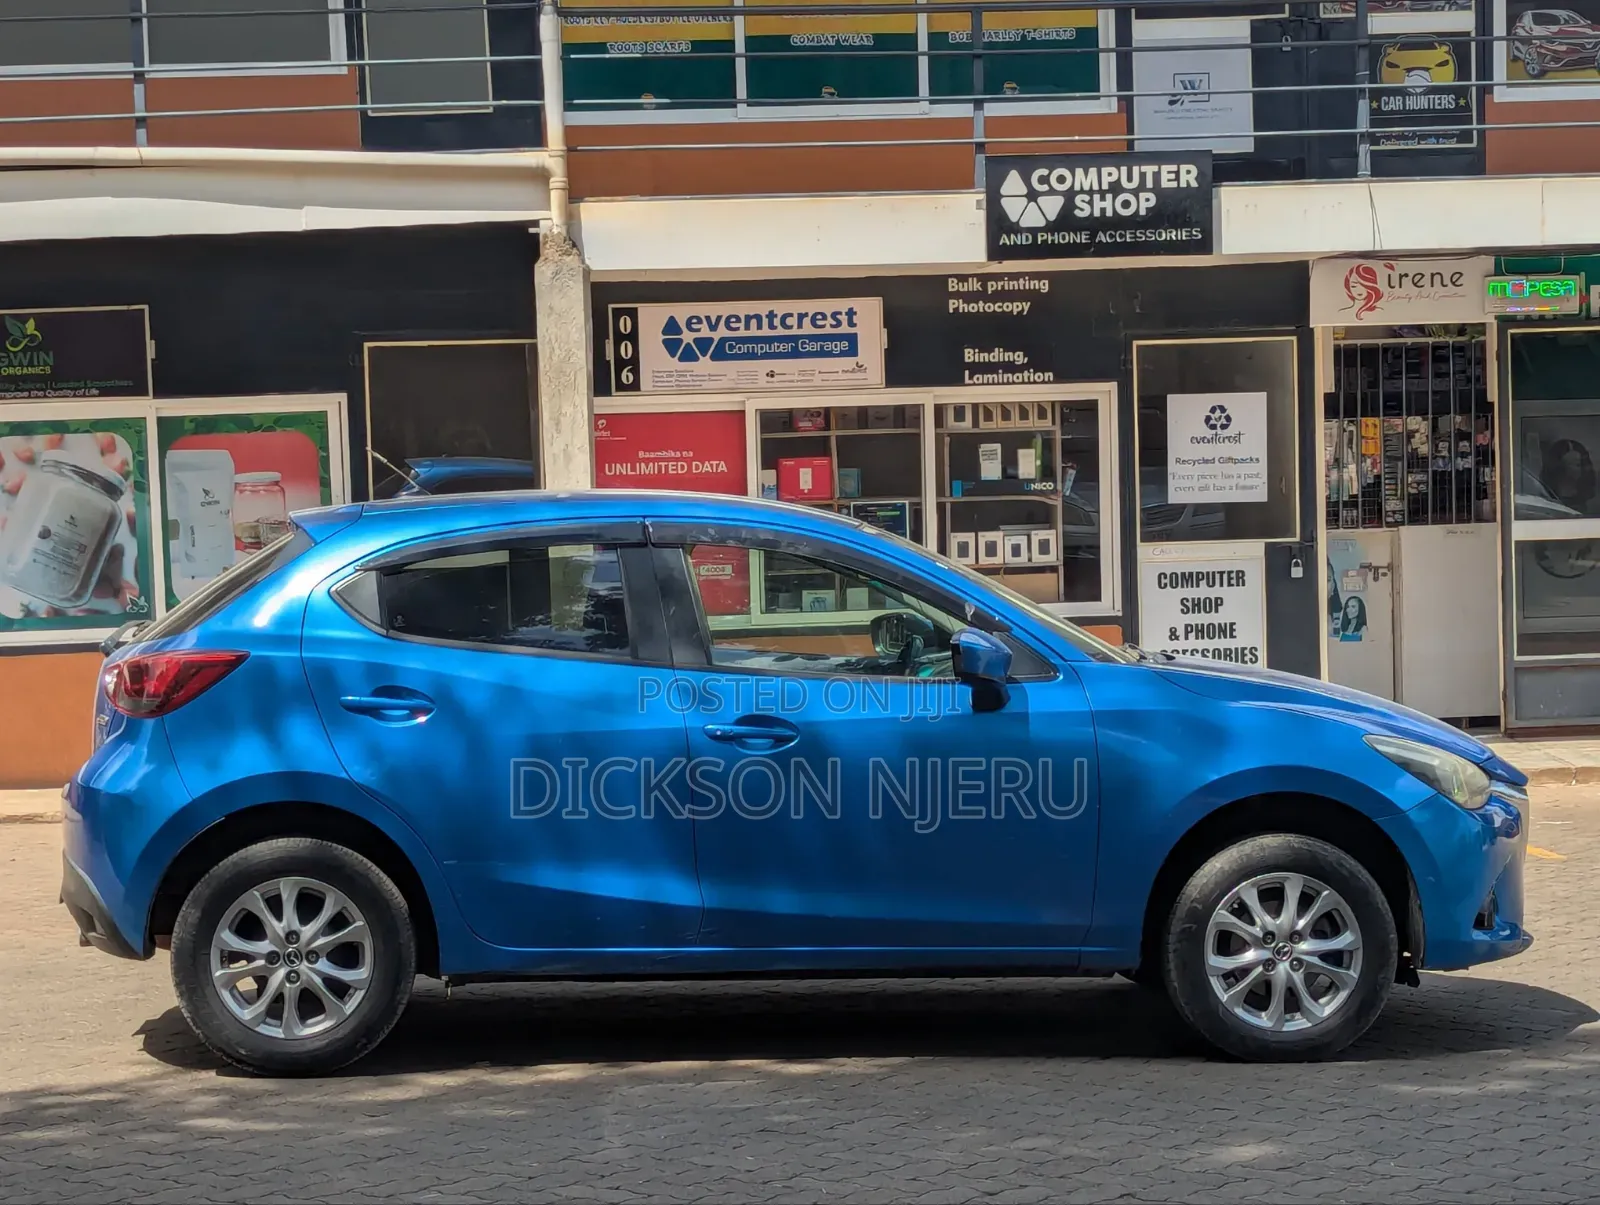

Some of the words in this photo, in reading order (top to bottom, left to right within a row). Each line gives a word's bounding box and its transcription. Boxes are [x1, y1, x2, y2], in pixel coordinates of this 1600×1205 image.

[790, 34, 838, 46] COMBAT
[839, 34, 874, 46] WEAR
[949, 31, 972, 43] BOB
[1026, 28, 1076, 40] T-SHIRTS
[607, 42, 647, 53] ROOTS
[648, 41, 692, 53] SCARFS
[1381, 96, 1403, 111] CAR
[1405, 94, 1456, 111] HUNTERS
[1030, 164, 1198, 192] COMPUTER
[1073, 192, 1157, 218] SHOP
[999, 232, 1033, 246] AND
[1037, 230, 1091, 245] PHONE
[1095, 228, 1202, 243] ACCESSORIES
[948, 277, 982, 292] Bulk
[987, 276, 1049, 294] printing
[948, 299, 1031, 315] Photocopy
[685, 307, 858, 332] eventcrest
[725, 341, 795, 356] Computer
[798, 338, 849, 354] Garage
[964, 347, 1028, 365] Binding,
[1, 366, 51, 376] ORGANICS
[964, 368, 1054, 384] Lamination
[605, 462, 687, 475] UNLIMITED
[692, 460, 728, 474] DATA
[1175, 457, 1215, 467] Recycled
[1024, 482, 1054, 491] UNICO
[1157, 570, 1246, 589] COMPUTER
[1180, 597, 1224, 614] SHOP
[1168, 627, 1180, 641] &
[1184, 622, 1237, 640] PHONE
[1160, 646, 1259, 665] SORIES
